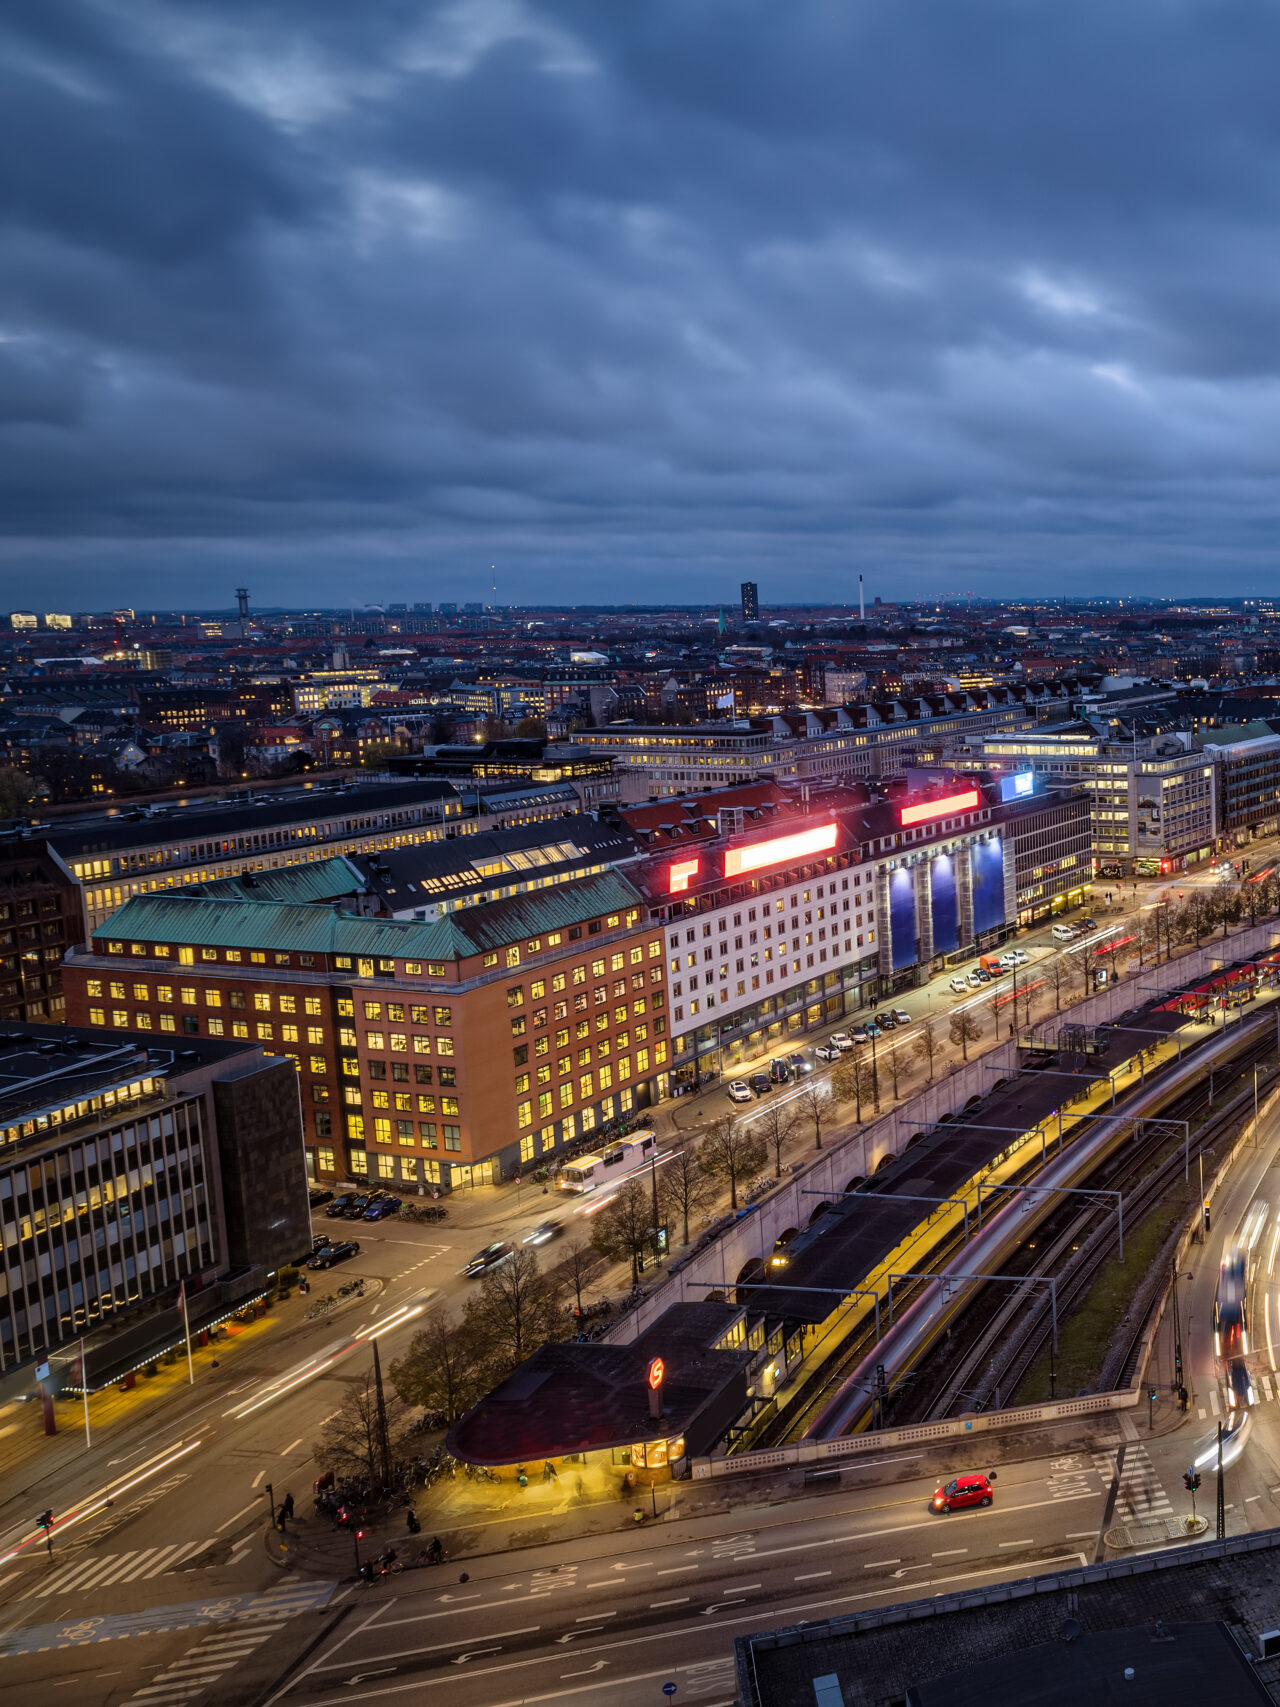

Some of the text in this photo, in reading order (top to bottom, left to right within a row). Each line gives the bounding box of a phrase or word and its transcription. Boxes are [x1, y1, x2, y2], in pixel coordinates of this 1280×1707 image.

[1046, 1475, 1091, 1498] BUS
[712, 1534, 755, 1559] BUS
[530, 1565, 579, 1593] BUS
[686, 1660, 735, 1695] BUS
